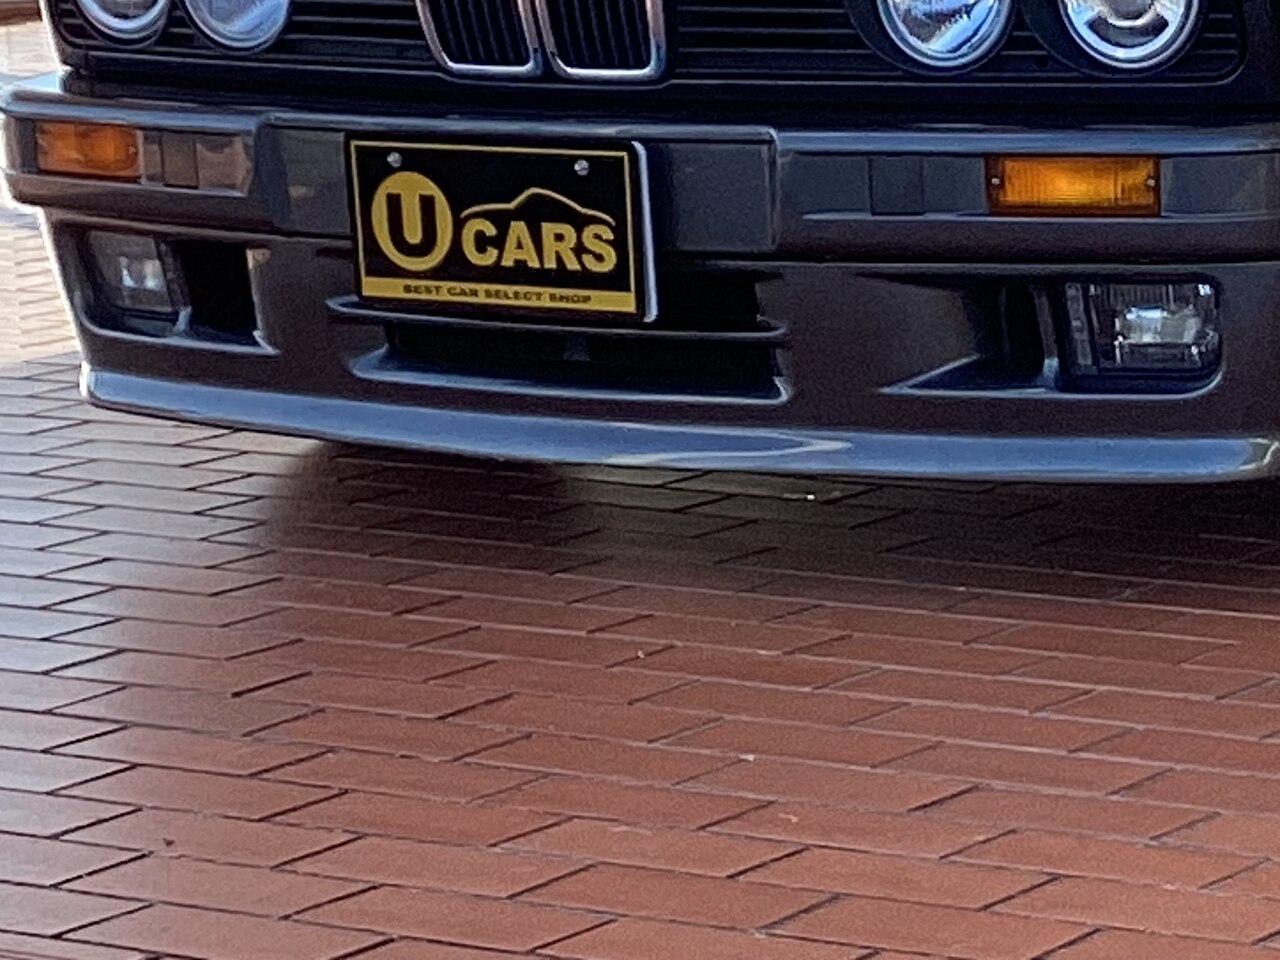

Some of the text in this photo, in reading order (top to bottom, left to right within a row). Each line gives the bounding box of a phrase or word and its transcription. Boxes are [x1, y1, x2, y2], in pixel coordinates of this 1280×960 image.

[385, 191, 618, 273] U CARS
[402, 283, 592, 305] BEST CAR SELECT SHOP
